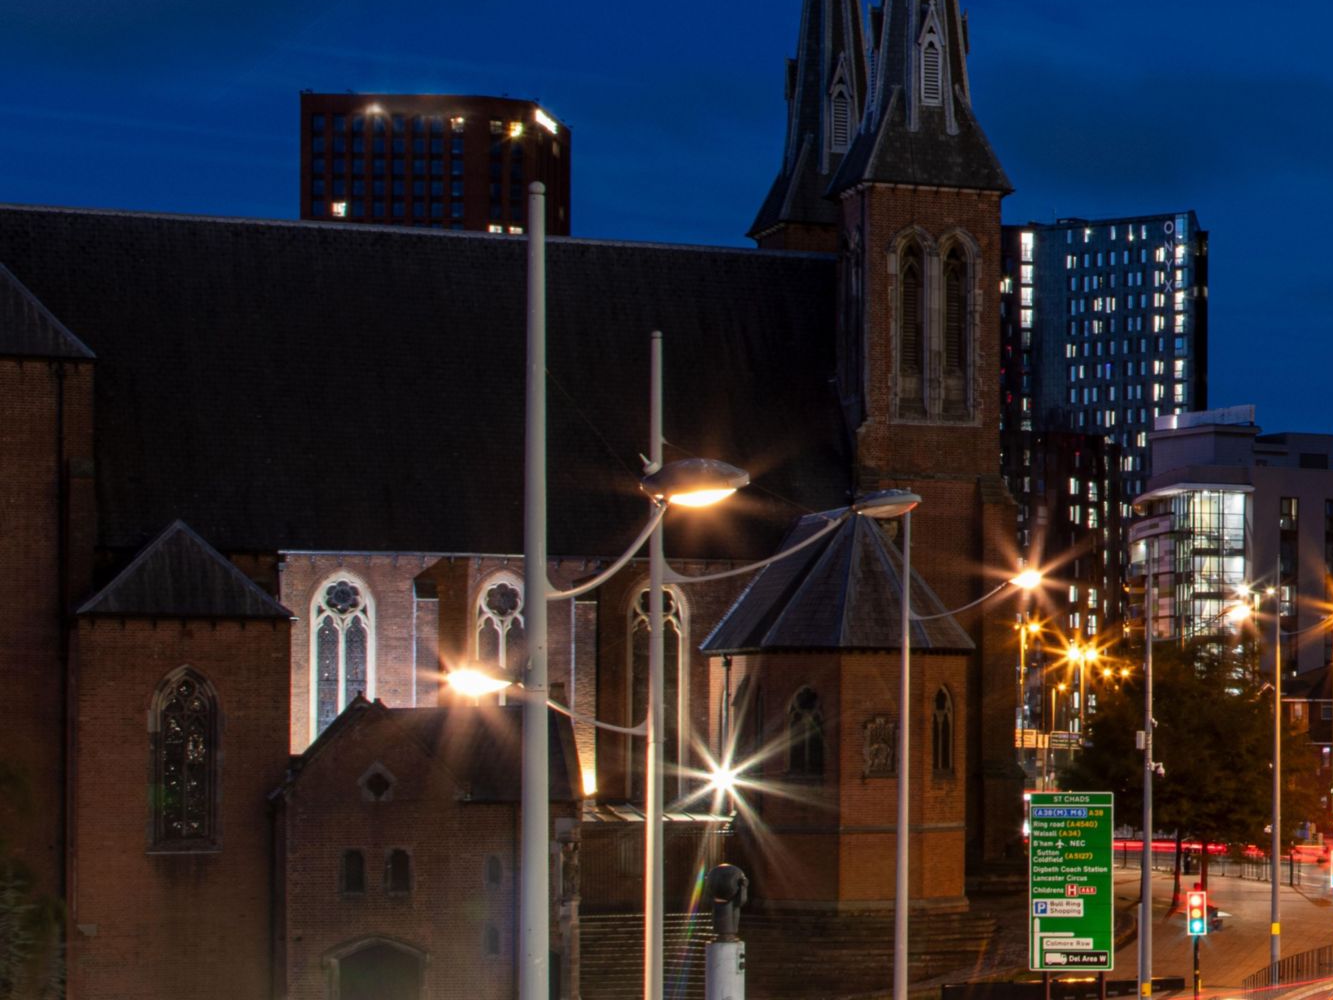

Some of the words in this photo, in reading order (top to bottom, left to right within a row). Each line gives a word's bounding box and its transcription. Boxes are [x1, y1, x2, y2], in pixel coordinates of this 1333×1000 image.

[1164, 221, 1174, 292] ONYX
[1067, 885, 1077, 896] H
[1038, 903, 1045, 912] P
